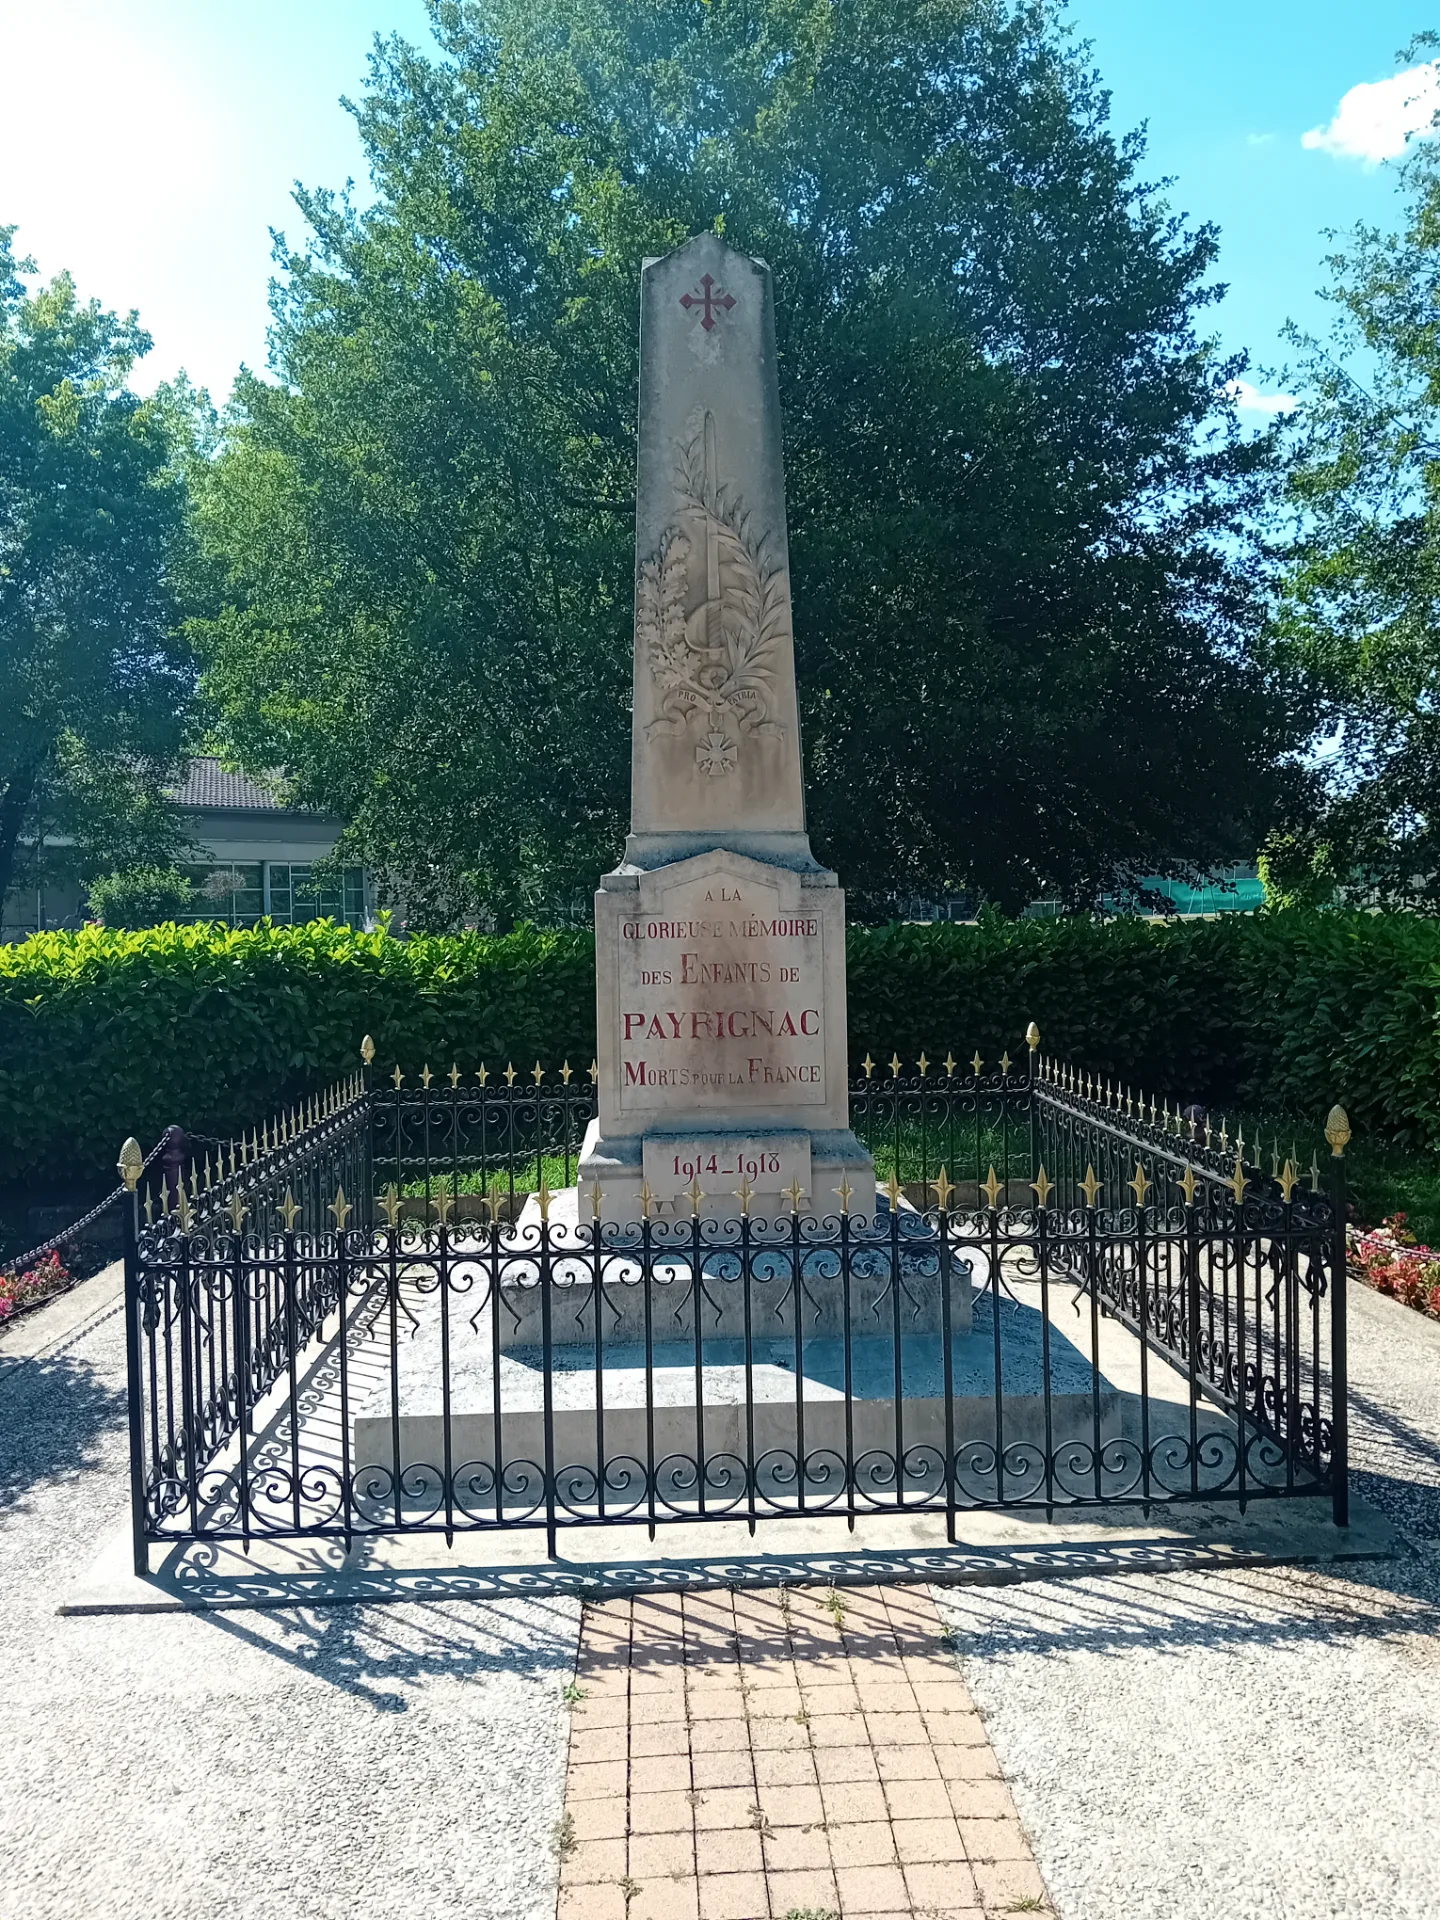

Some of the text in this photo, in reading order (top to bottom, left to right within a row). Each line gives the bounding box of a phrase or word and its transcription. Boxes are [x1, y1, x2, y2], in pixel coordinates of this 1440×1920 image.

[677, 690, 757, 705] PRO PATRIA
[704, 888, 742, 902] A LA
[623, 914, 818, 939] GLORIEUSE MÉMOIRE
[641, 953, 800, 985] DES ENFANTS DE
[623, 1009, 820, 1041] PAYRIGNAC
[624, 1058, 821, 1087] MORTS POUR LA FRANCE
